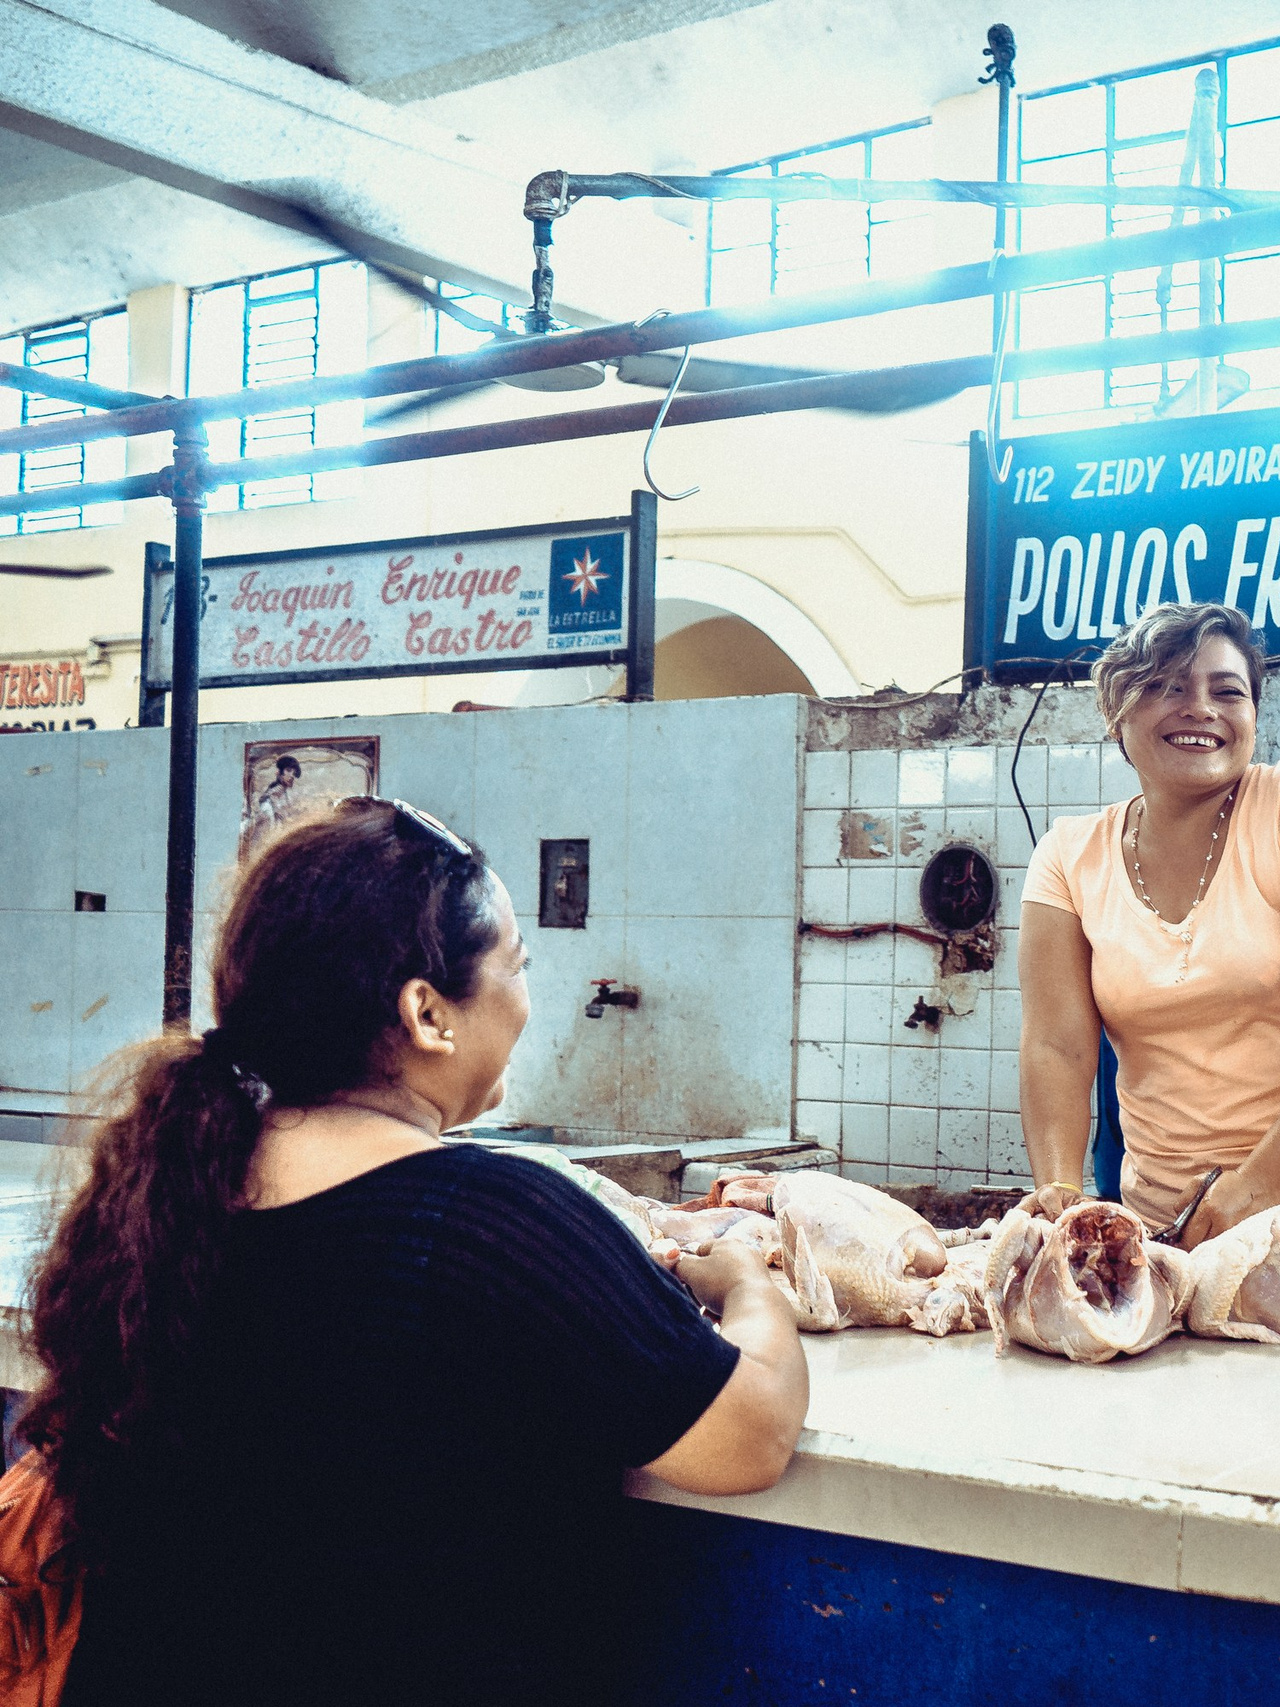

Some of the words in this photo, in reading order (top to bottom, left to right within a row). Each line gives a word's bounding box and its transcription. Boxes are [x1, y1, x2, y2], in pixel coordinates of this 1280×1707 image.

[1014, 466, 1055, 504] 112
[1071, 456, 1166, 500] ZEIDY
[231, 564, 354, 628] Joaquin
[381, 551, 521, 610] Enrique
[1003, 523, 1208, 644] POLLOS
[232, 617, 371, 669] Castillo
[405, 608, 533, 657] Castro
[562, 610, 617, 627] ESTRELLA
[0, 662, 85, 709] TERESITA
